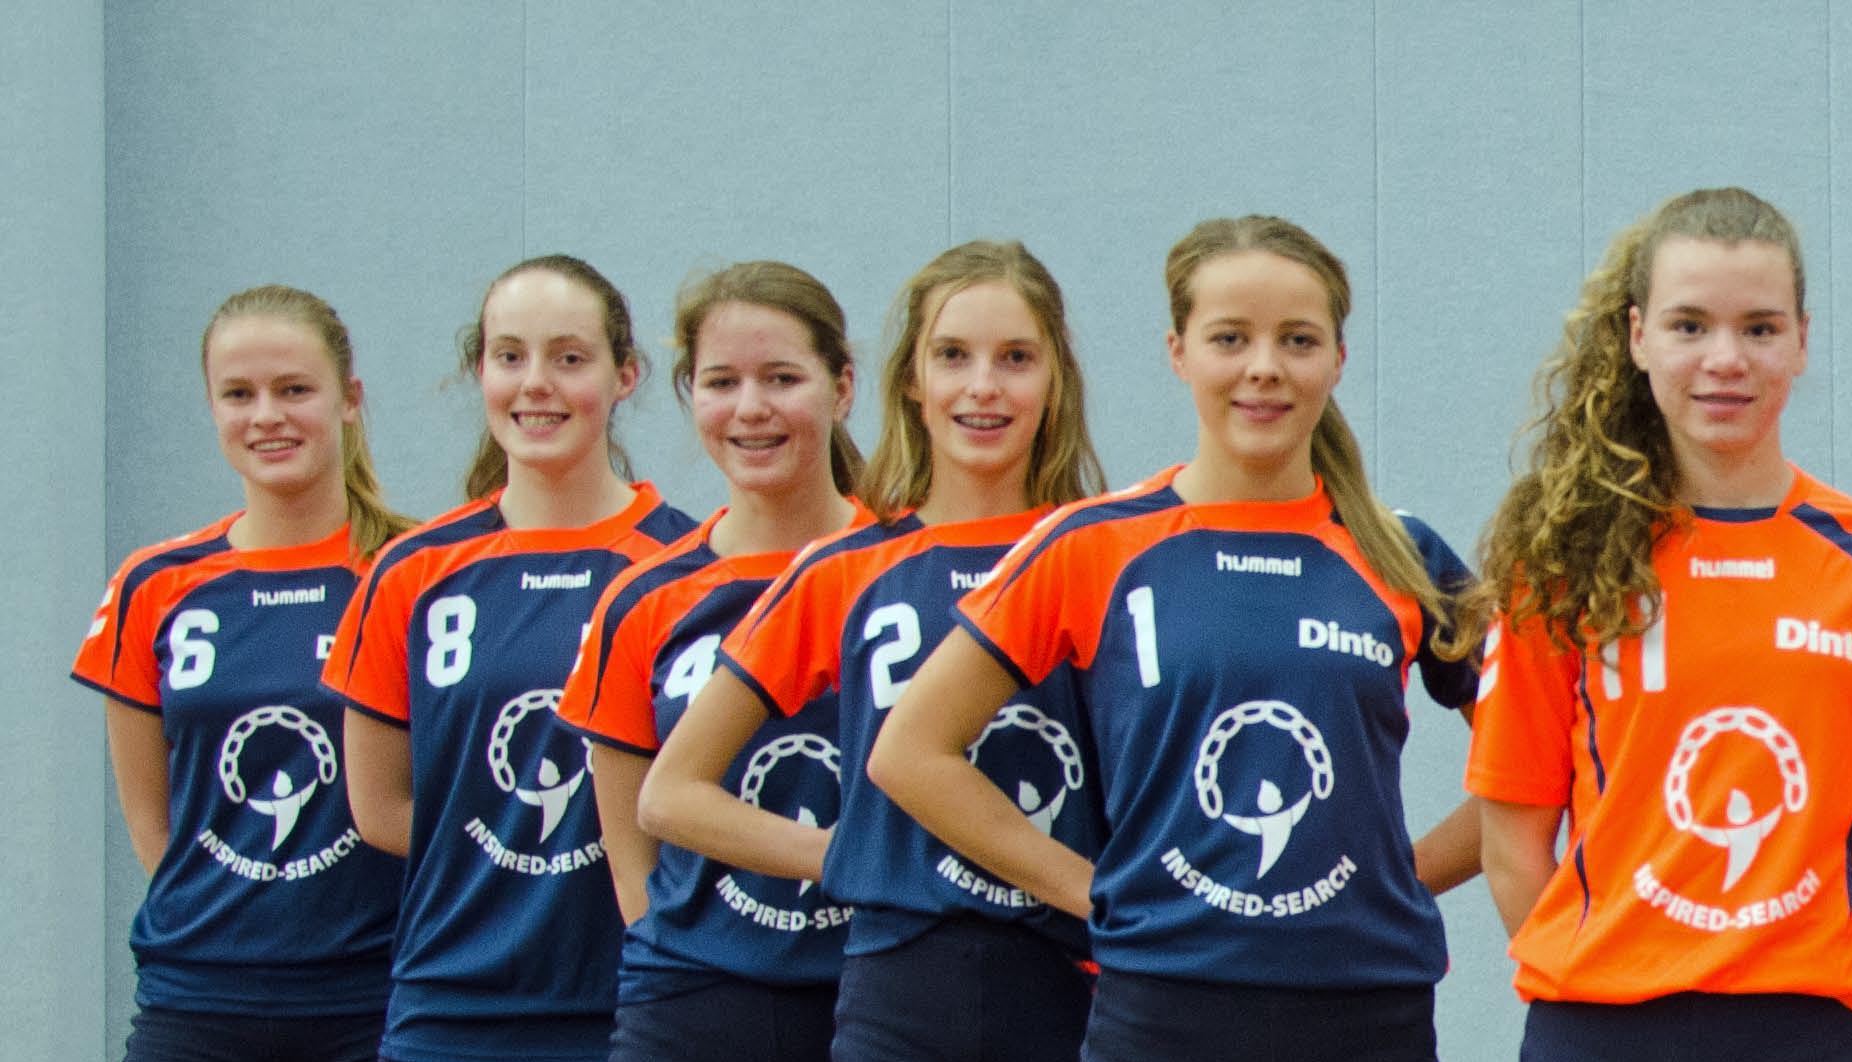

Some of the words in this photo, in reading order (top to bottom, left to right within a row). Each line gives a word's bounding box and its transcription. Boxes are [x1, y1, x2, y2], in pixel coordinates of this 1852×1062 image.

[521, 570, 592, 590] hummel
[1216, 551, 1301, 576] hummel
[1690, 557, 1775, 579] hummel
[253, 585, 326, 607] hummel
[168, 608, 219, 690] 6
[425, 594, 477, 688] 8
[864, 602, 921, 710] 2
[1126, 586, 1161, 688] 1
[1299, 618, 1393, 668] Dinto
[663, 634, 721, 705] 4
[198, 827, 363, 881] INSPIRED-SEARCH
[1161, 847, 1358, 918] INSPIRED-SEARCH
